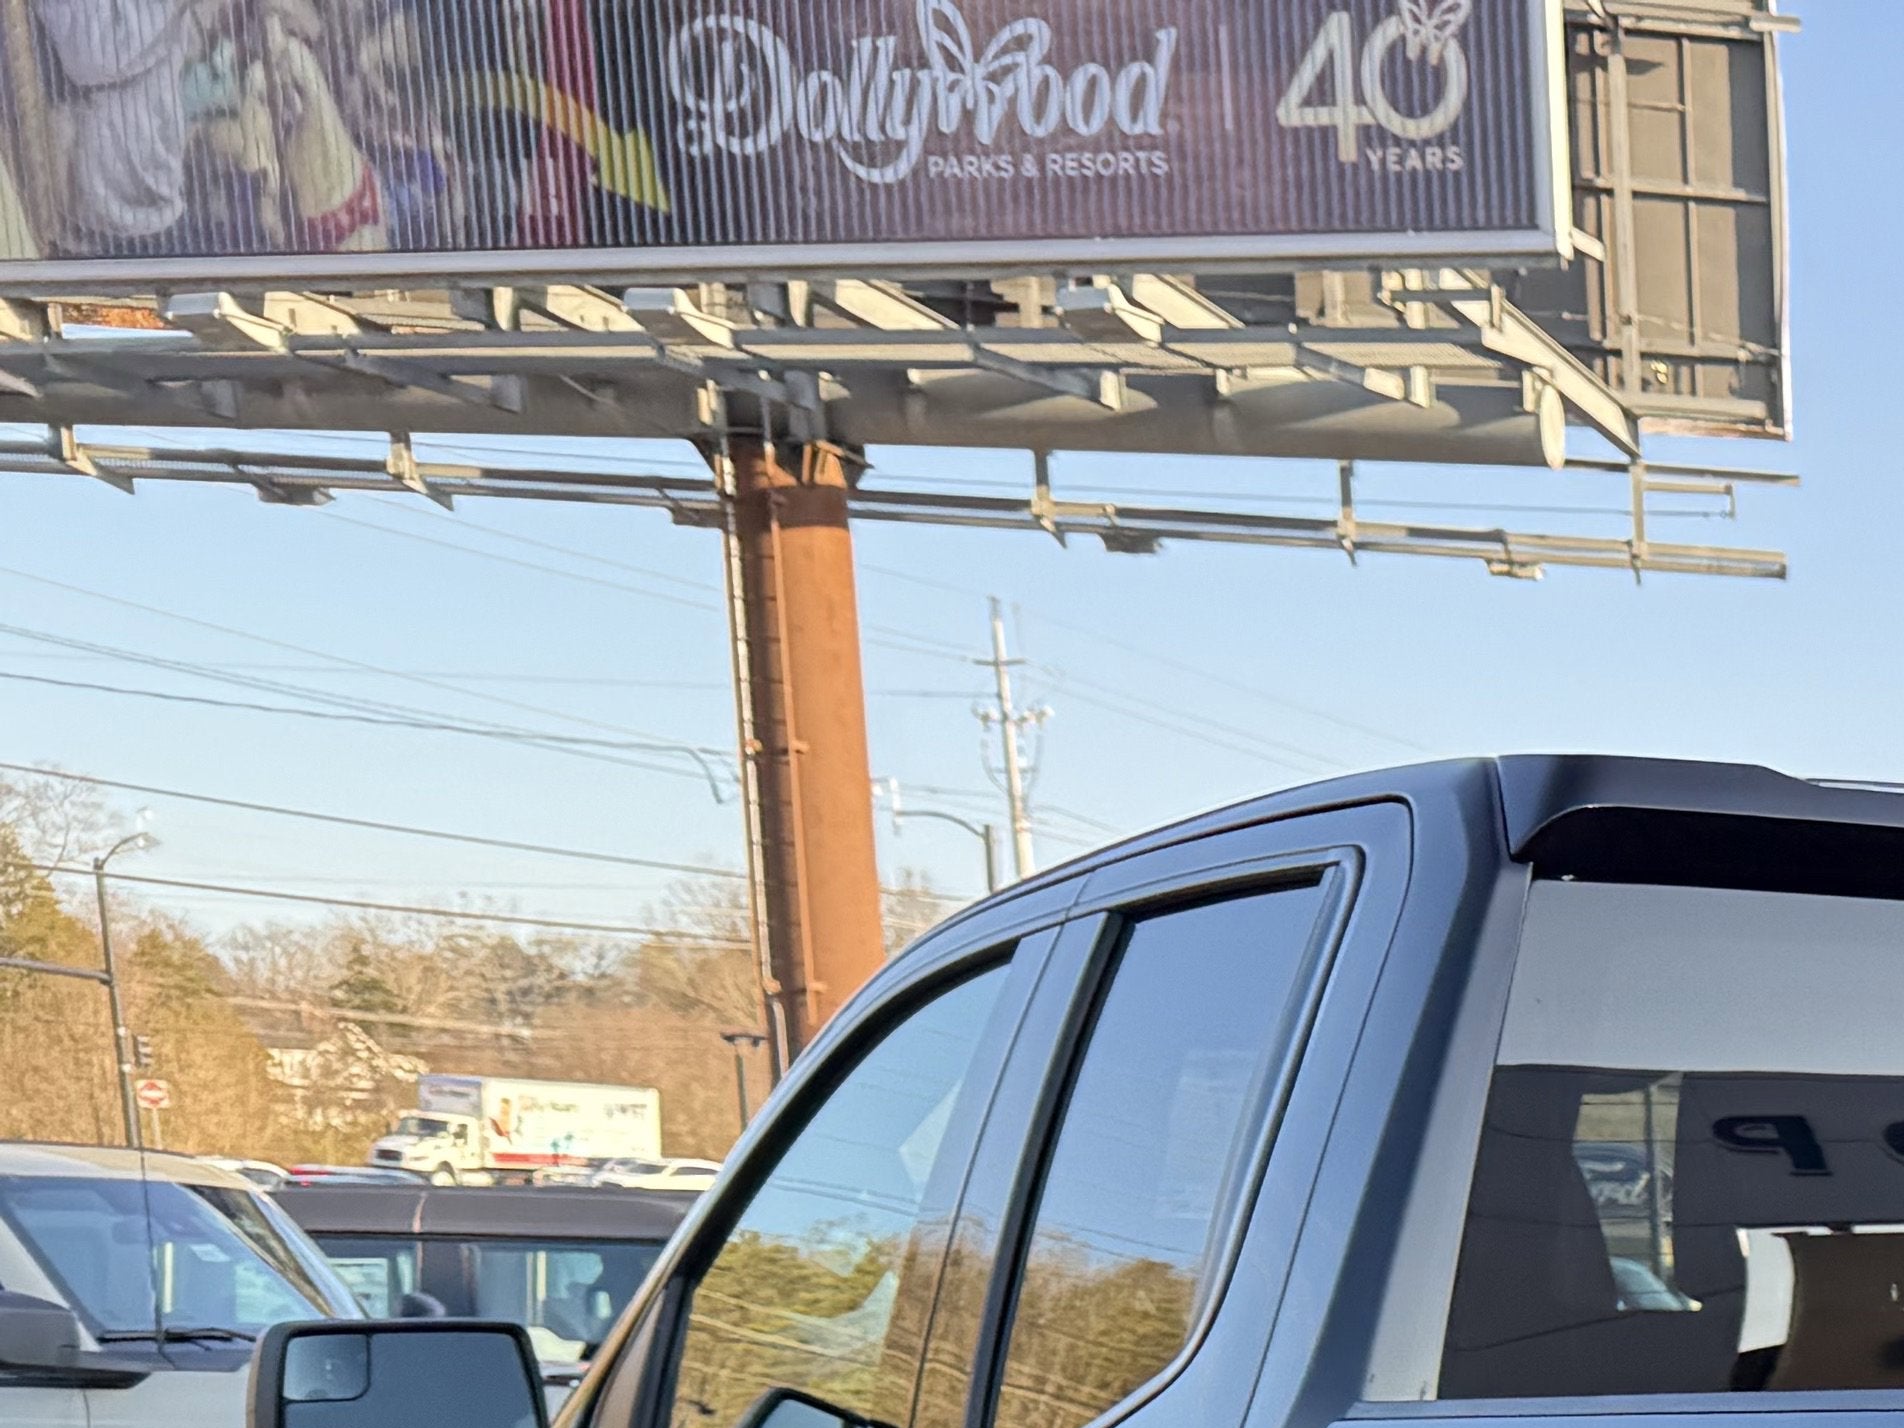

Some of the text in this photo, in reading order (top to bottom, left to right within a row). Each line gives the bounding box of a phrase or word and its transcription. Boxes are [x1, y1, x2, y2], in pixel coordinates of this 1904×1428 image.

[1276, 11, 1468, 163] 40
[928, 150, 1169, 179] PARKS & RESORTS
[1366, 146, 1465, 173] YEARS
